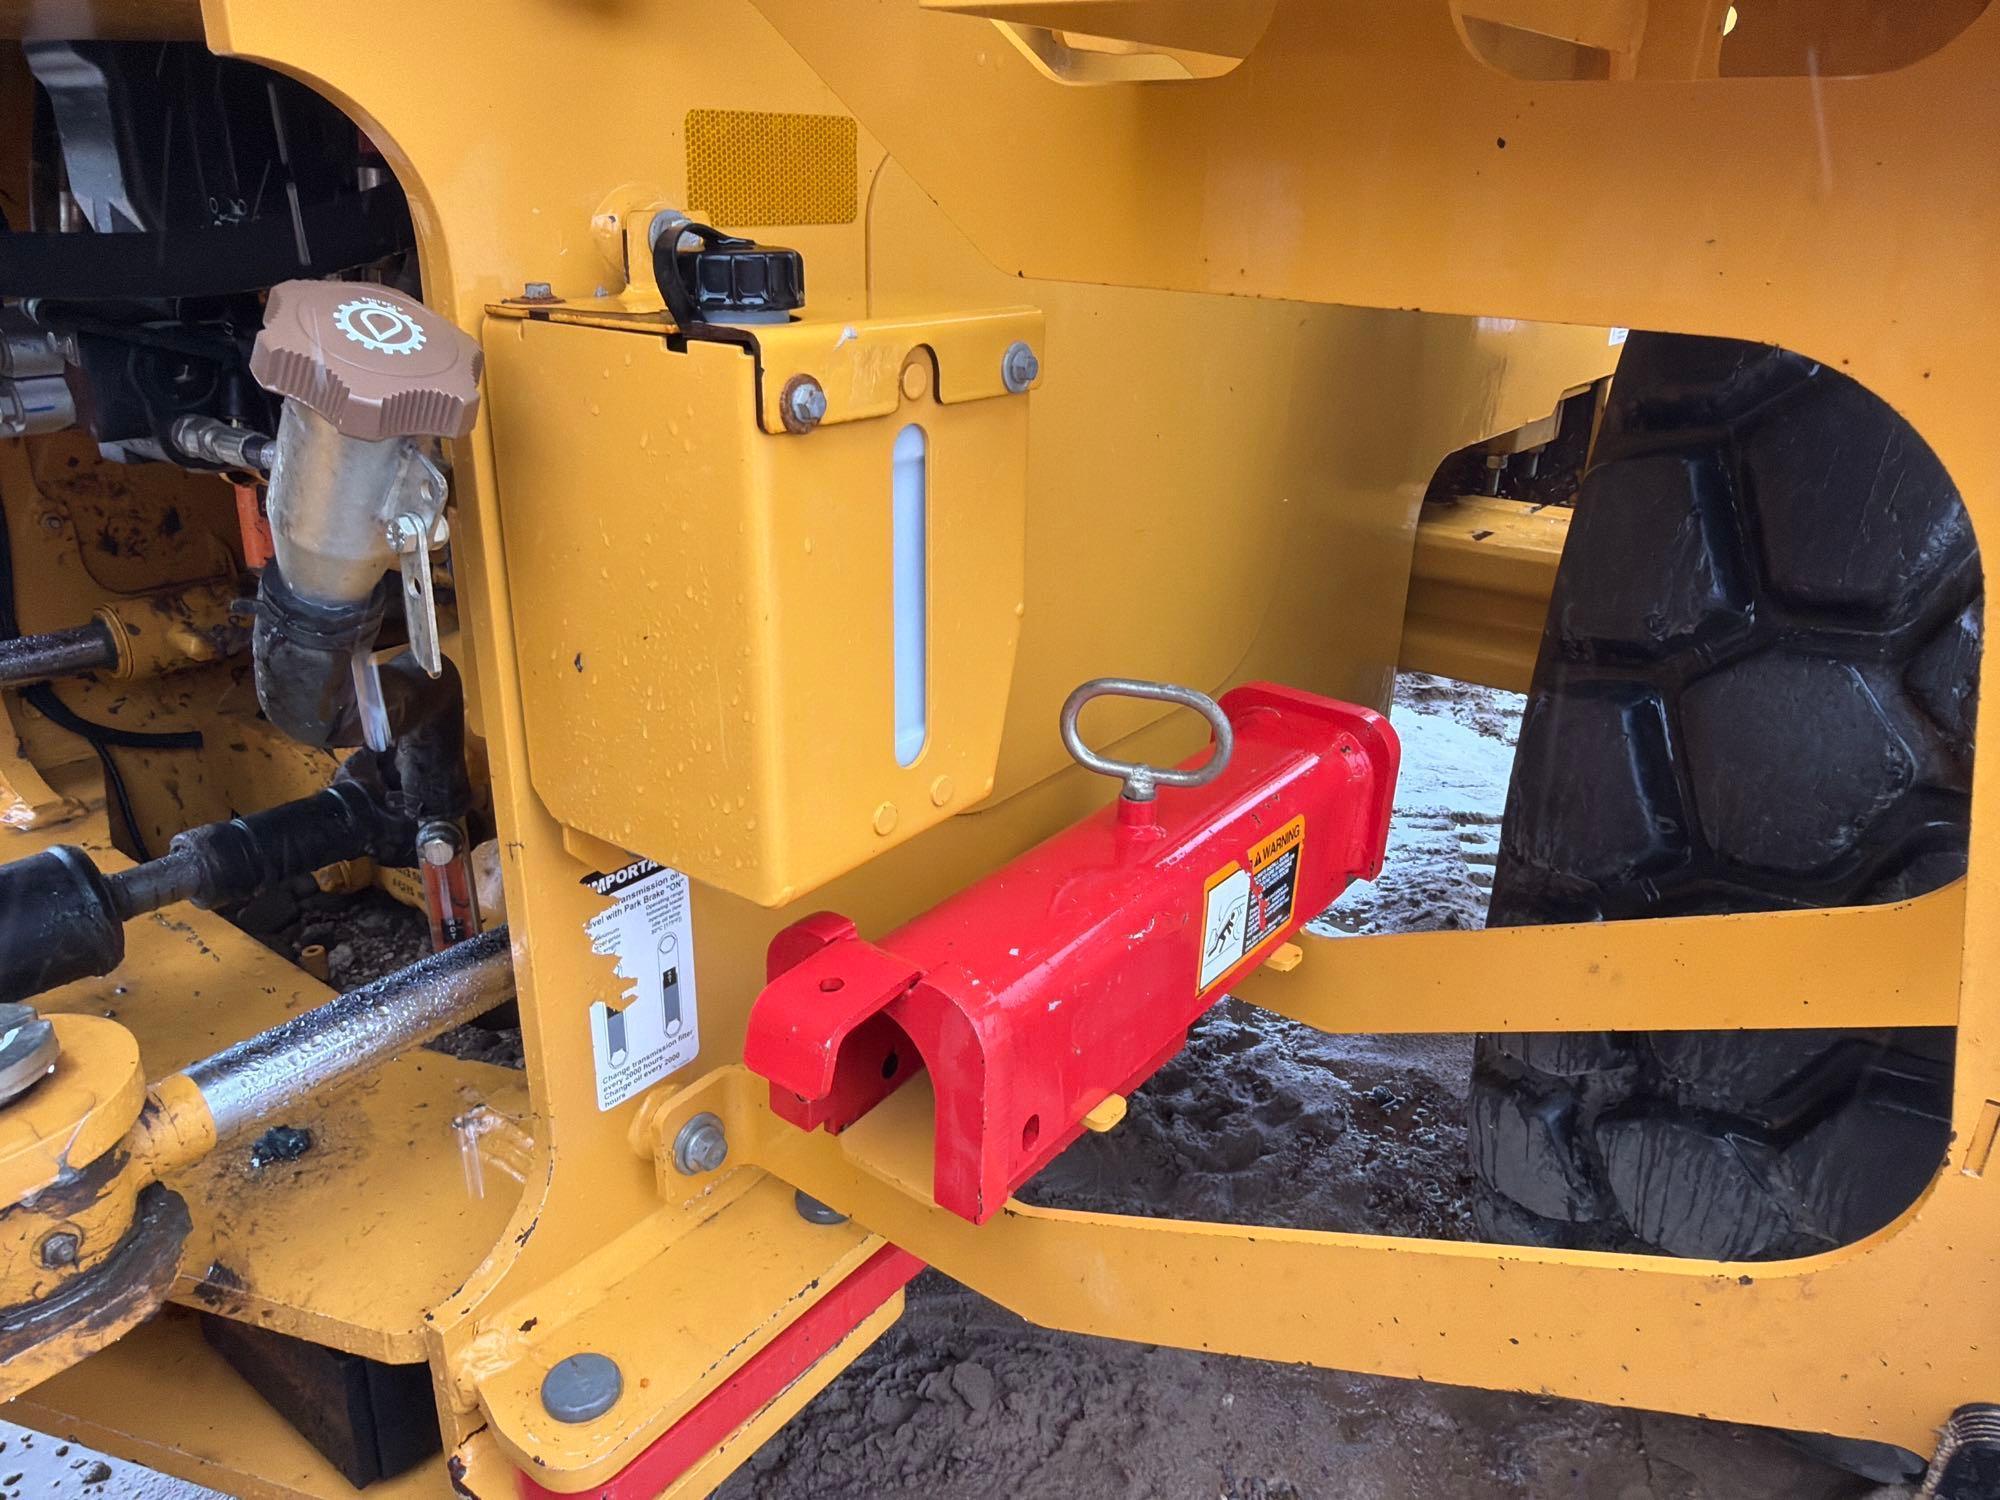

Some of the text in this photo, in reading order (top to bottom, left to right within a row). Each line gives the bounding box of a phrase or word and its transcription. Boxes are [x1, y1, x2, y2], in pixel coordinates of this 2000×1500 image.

[1263, 824, 1300, 860] WARNING
[588, 860, 659, 894] MPORTA
[606, 908, 622, 920] with
[624, 901, 641, 913] Park
[643, 889, 664, 904] Brake
[603, 1066, 631, 1084] Change
[632, 1039, 677, 1067] transmission
[678, 1029, 693, 1041] filter
[604, 1081, 632, 1100] Change
[634, 1074, 643, 1084] oil
[644, 1063, 663, 1078] every
[664, 1052, 681, 1066] 2000
[604, 1078, 623, 1092] every
[626, 1067, 642, 1080] 2000
